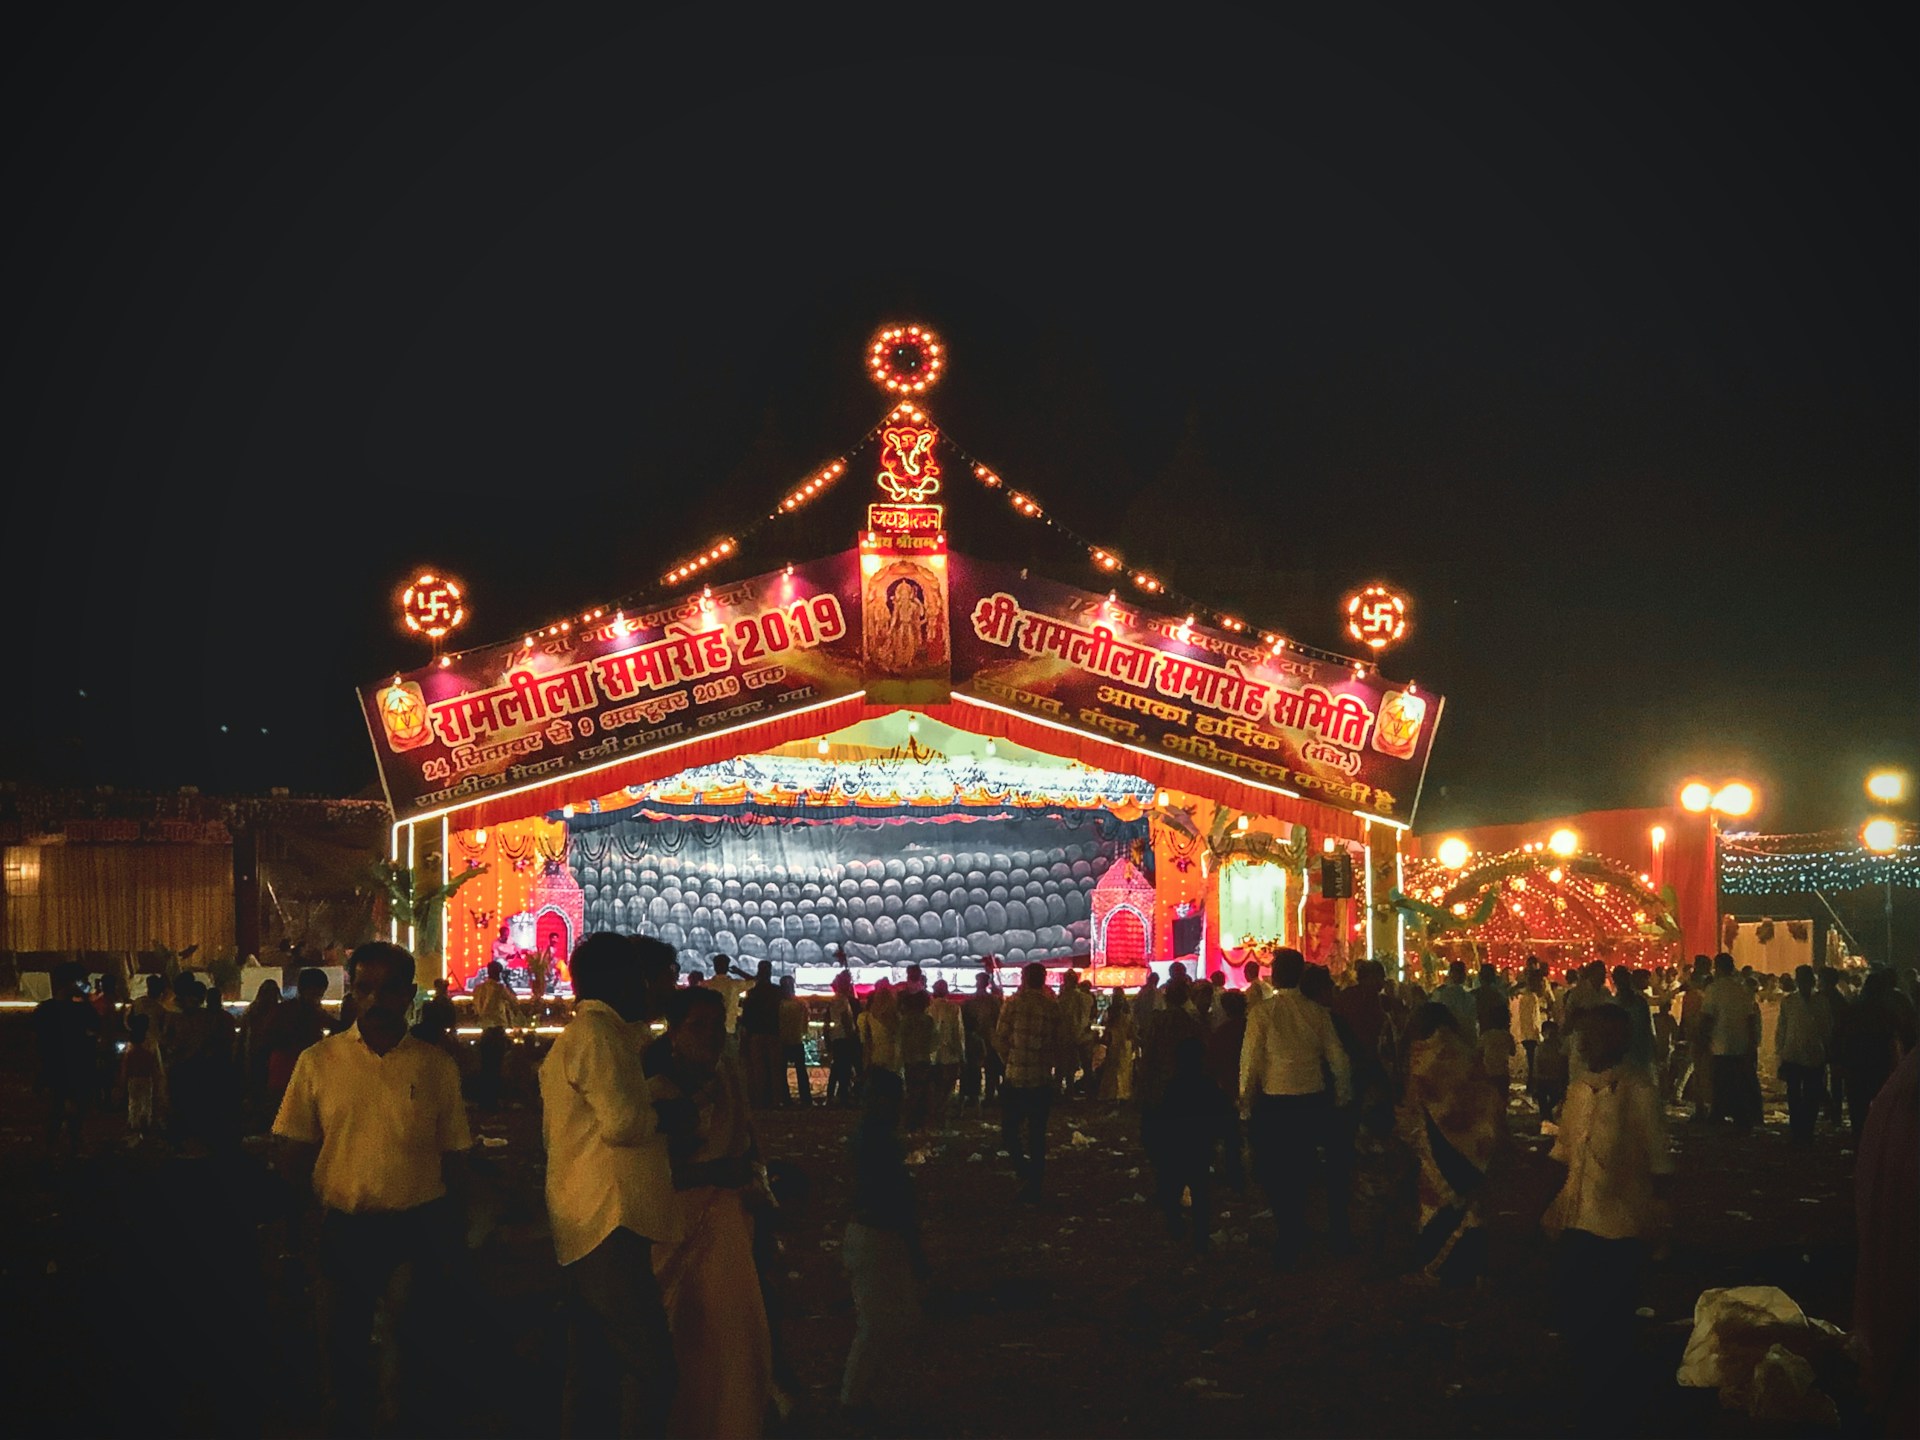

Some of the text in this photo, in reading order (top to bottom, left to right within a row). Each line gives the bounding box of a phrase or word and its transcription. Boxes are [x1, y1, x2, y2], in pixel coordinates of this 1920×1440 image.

[429, 594, 846, 746] रामलीला समारोह 2019
[970, 592, 1374, 751] श्री रामलीला समारोह समिति
[1281, 658, 1322, 679] वर्ष
[422, 665, 786, 781] 24 सितम्बर से 9 अक्टूबर 2019 तक
[1097, 685, 1282, 751] आपका हार्दिक
[414, 773, 507, 807] रामलीला
[1163, 732, 1290, 781] अभिनन्दन
[1294, 769, 1371, 804] करती
